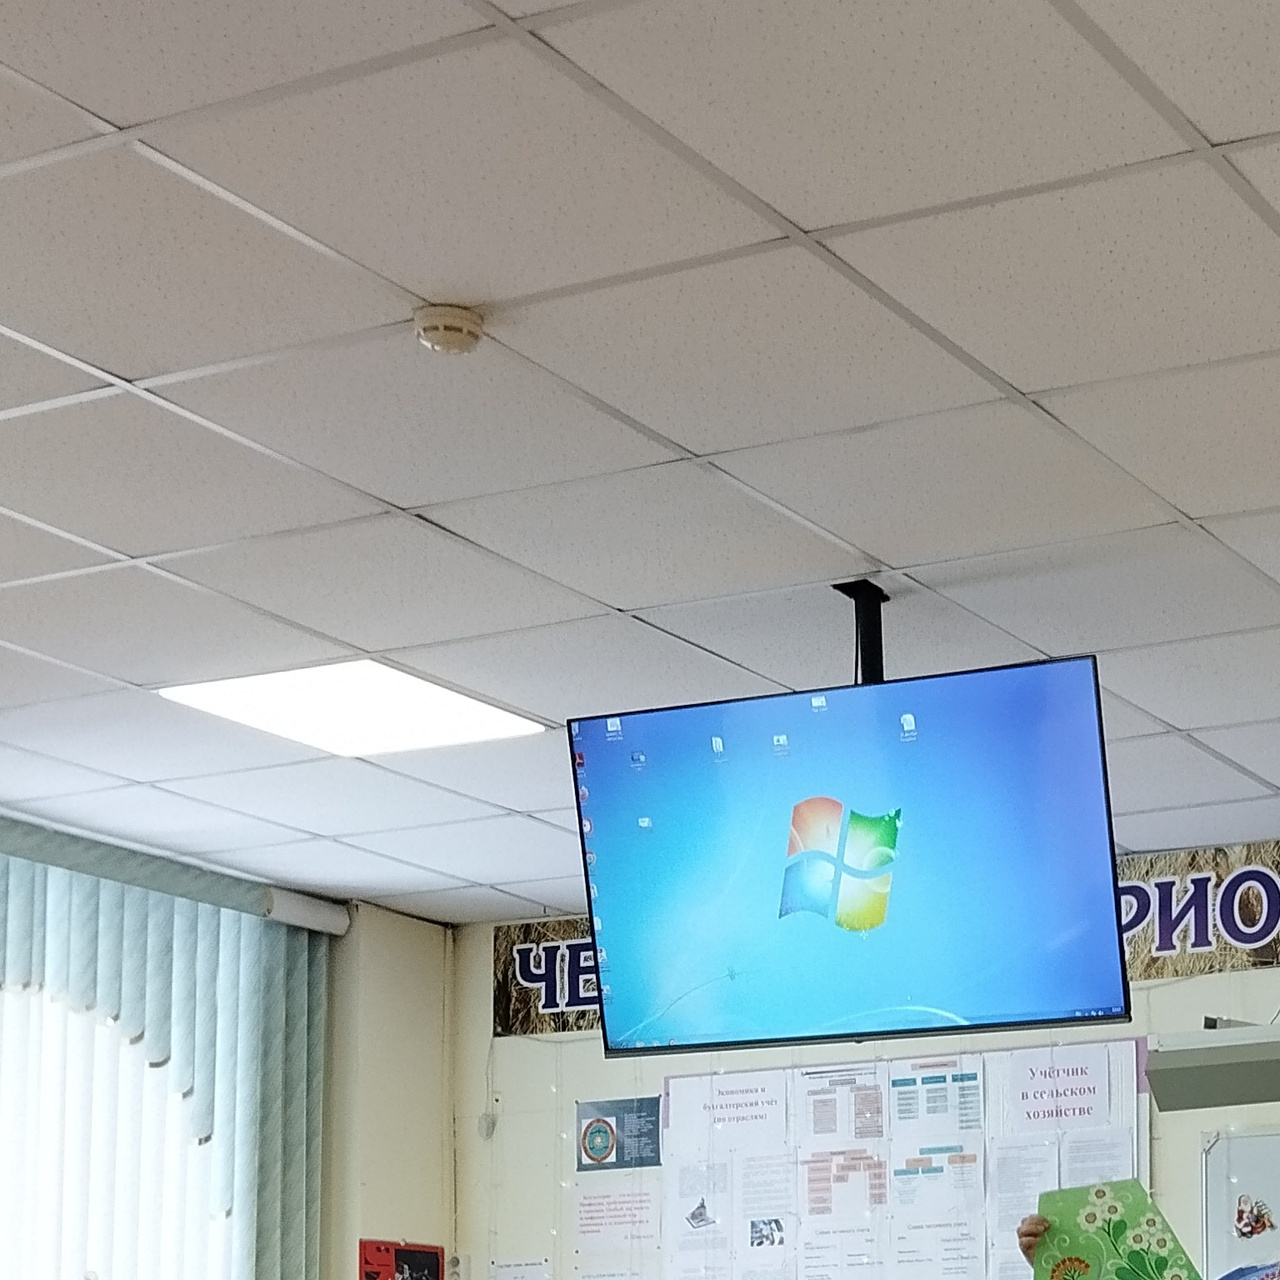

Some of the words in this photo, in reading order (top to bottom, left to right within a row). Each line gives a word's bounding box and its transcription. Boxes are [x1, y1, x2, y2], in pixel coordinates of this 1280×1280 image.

[1028, 1066, 1089, 1081] Учётчик
[1021, 1091, 1029, 1101] в
[1032, 1085, 1097, 1100] сельском
[1025, 1105, 1094, 1121] хозяйстве
